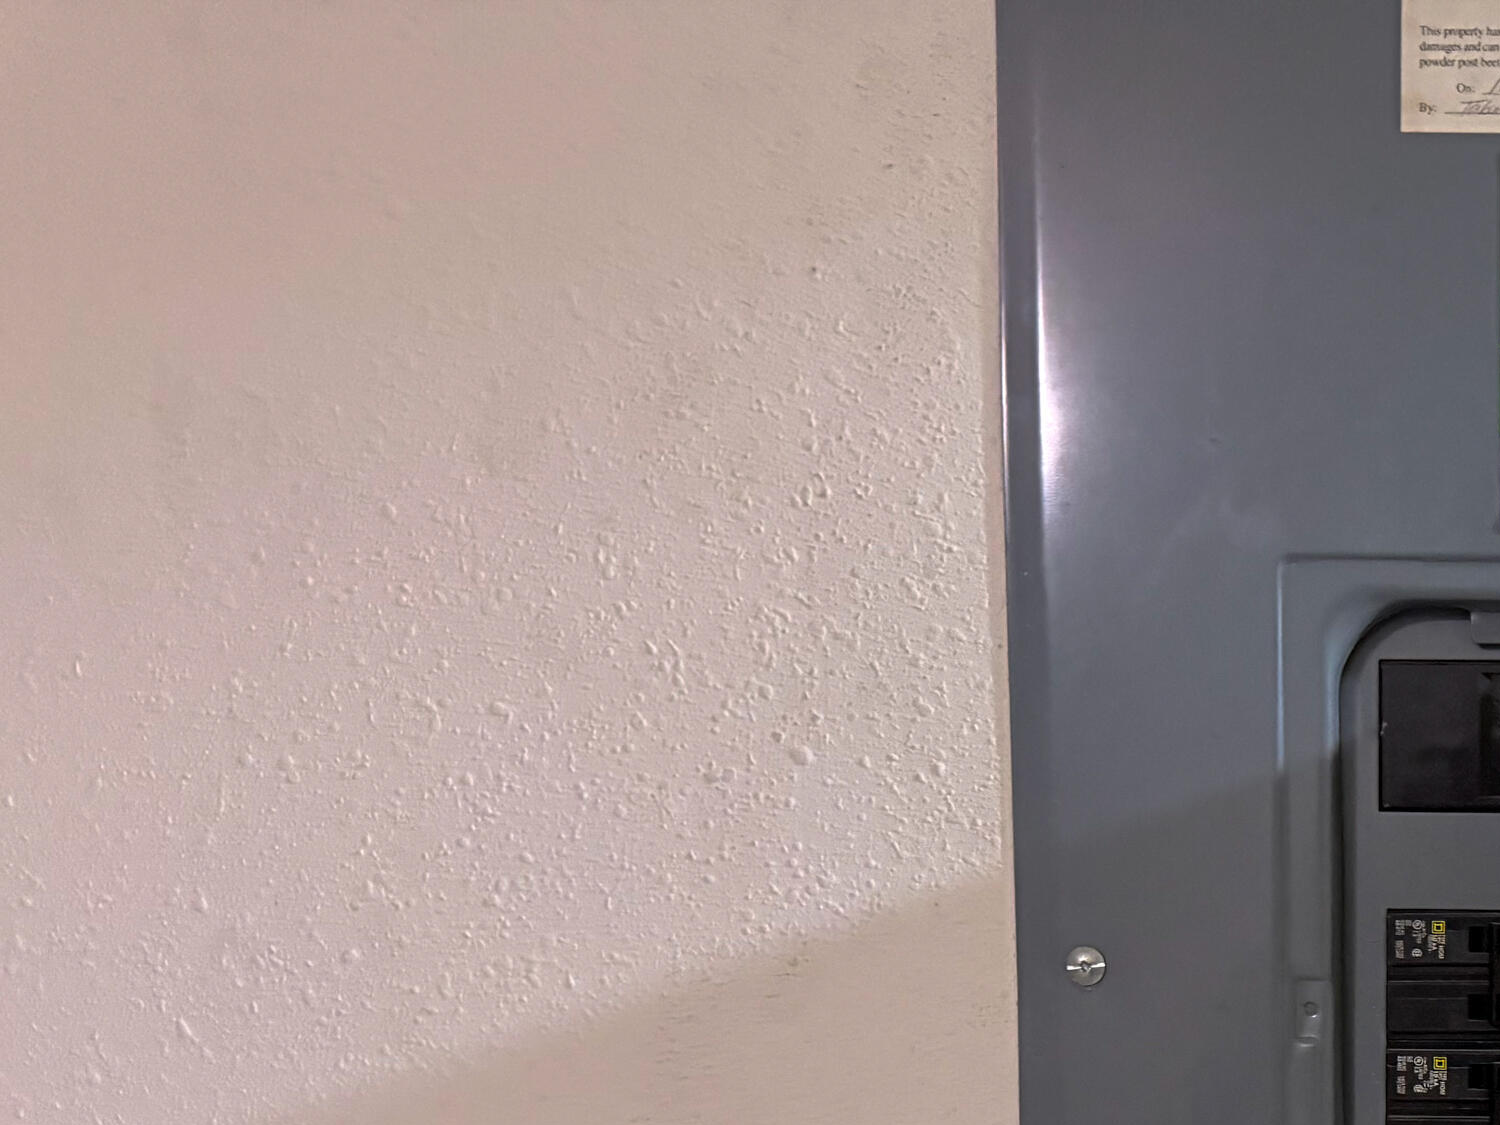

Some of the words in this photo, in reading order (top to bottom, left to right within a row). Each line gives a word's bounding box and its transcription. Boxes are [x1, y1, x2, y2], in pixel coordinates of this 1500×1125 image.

[1420, 25, 1441, 37] This
[1444, 27, 1482, 39] property
[1464, 42, 1481, 52] and
[1419, 58, 1456, 69] powder
